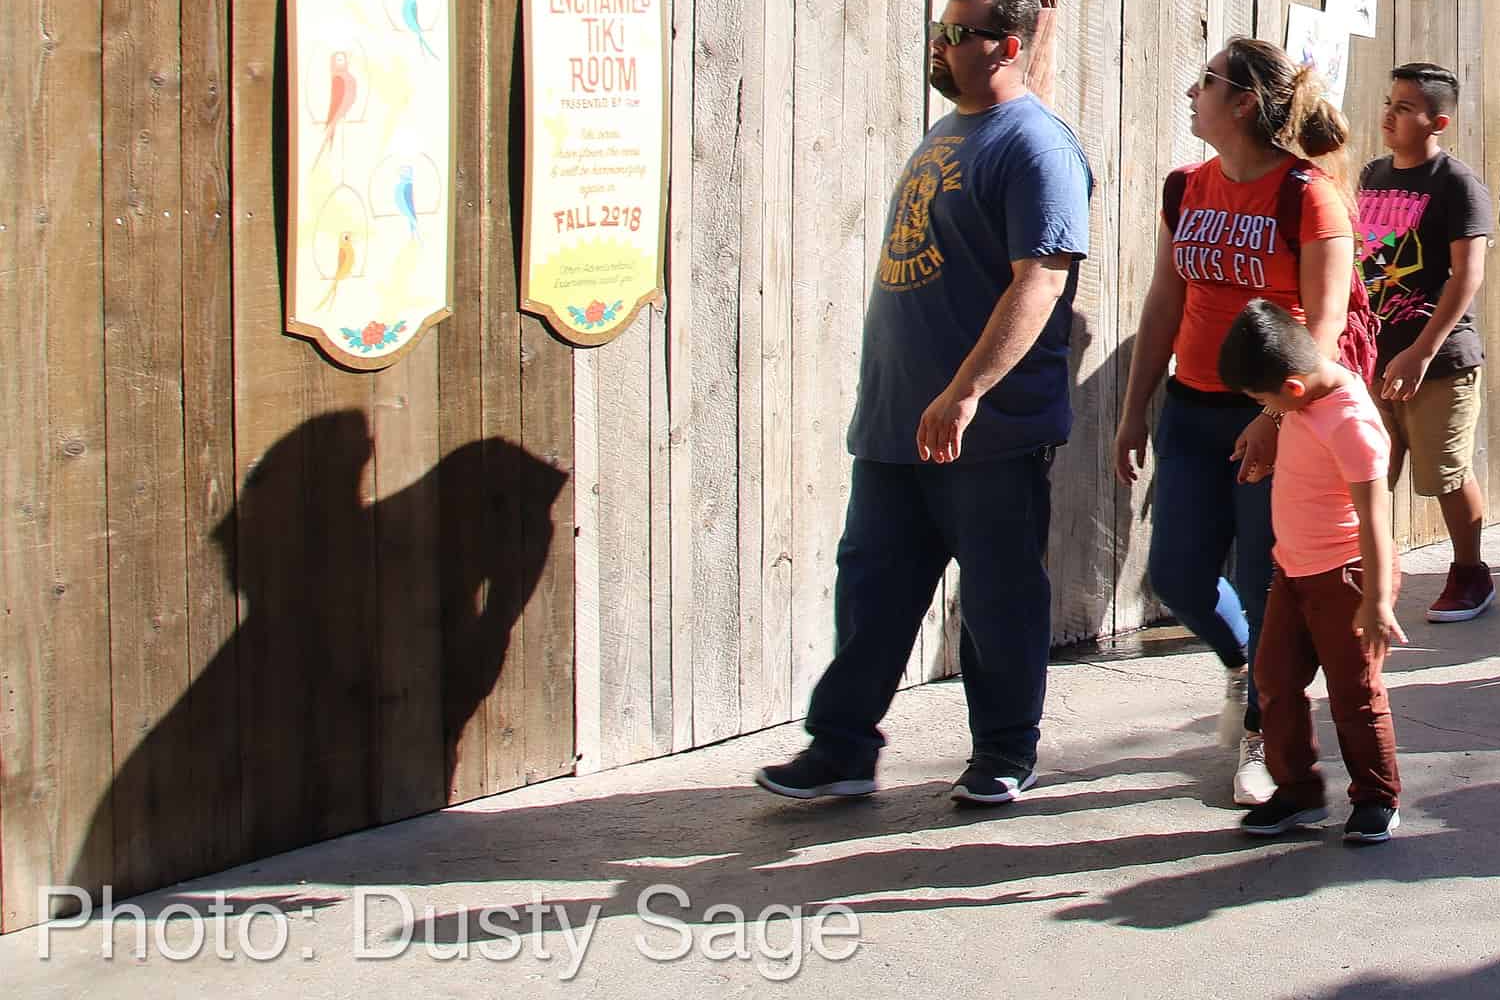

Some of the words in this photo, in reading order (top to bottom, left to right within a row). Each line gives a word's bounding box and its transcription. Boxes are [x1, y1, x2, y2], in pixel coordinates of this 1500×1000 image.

[581, 17, 624, 53] TIKI
[569, 56, 637, 93] ROOM
[553, 205, 597, 234] FALL
[600, 204, 642, 232] 2018
